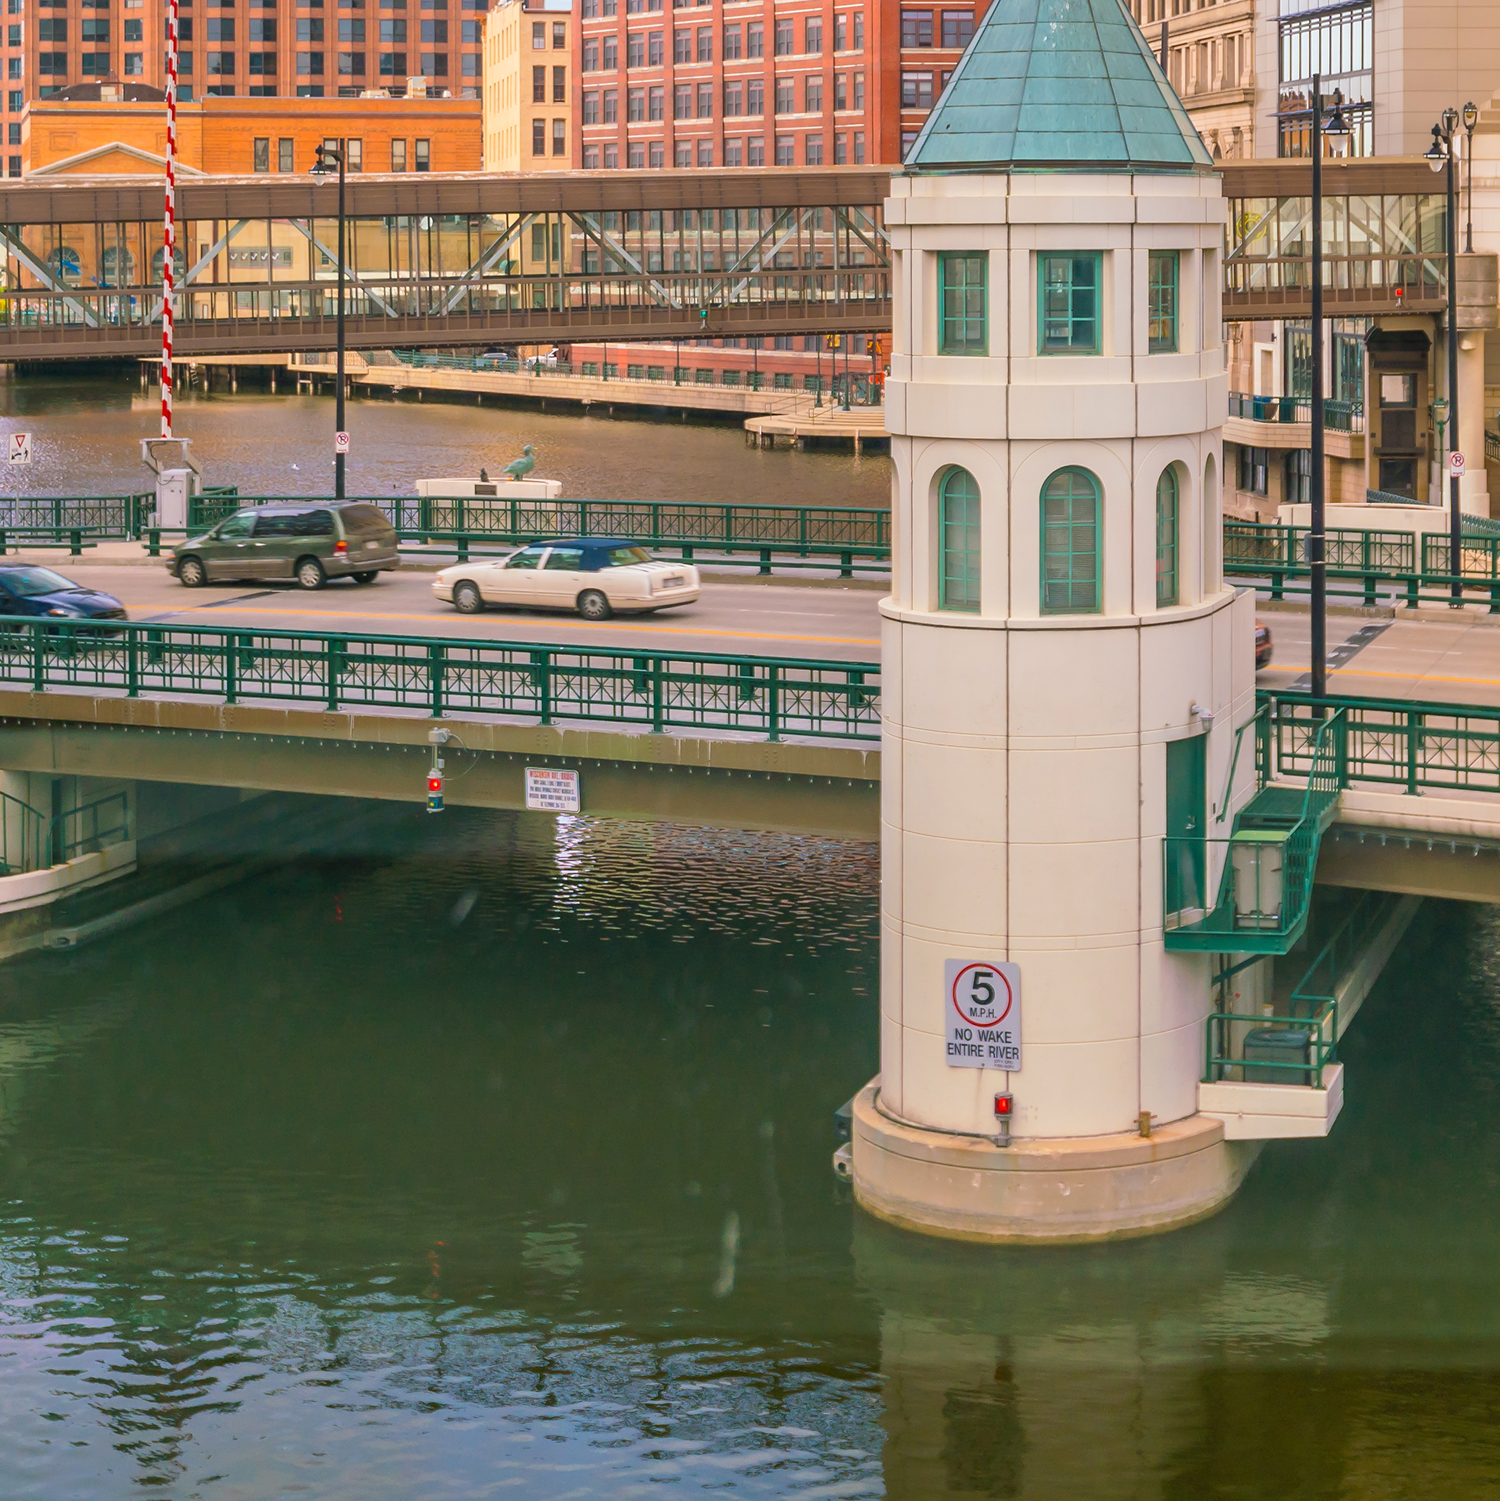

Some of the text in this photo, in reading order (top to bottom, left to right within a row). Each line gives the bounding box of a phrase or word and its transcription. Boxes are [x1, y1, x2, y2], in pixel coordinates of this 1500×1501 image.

[971, 971, 995, 1005] 5
[969, 1007, 997, 1018] M.P.H.
[955, 1028, 1012, 1043] NO WAKE
[947, 1043, 1019, 1059] ENTIRE RIVER
